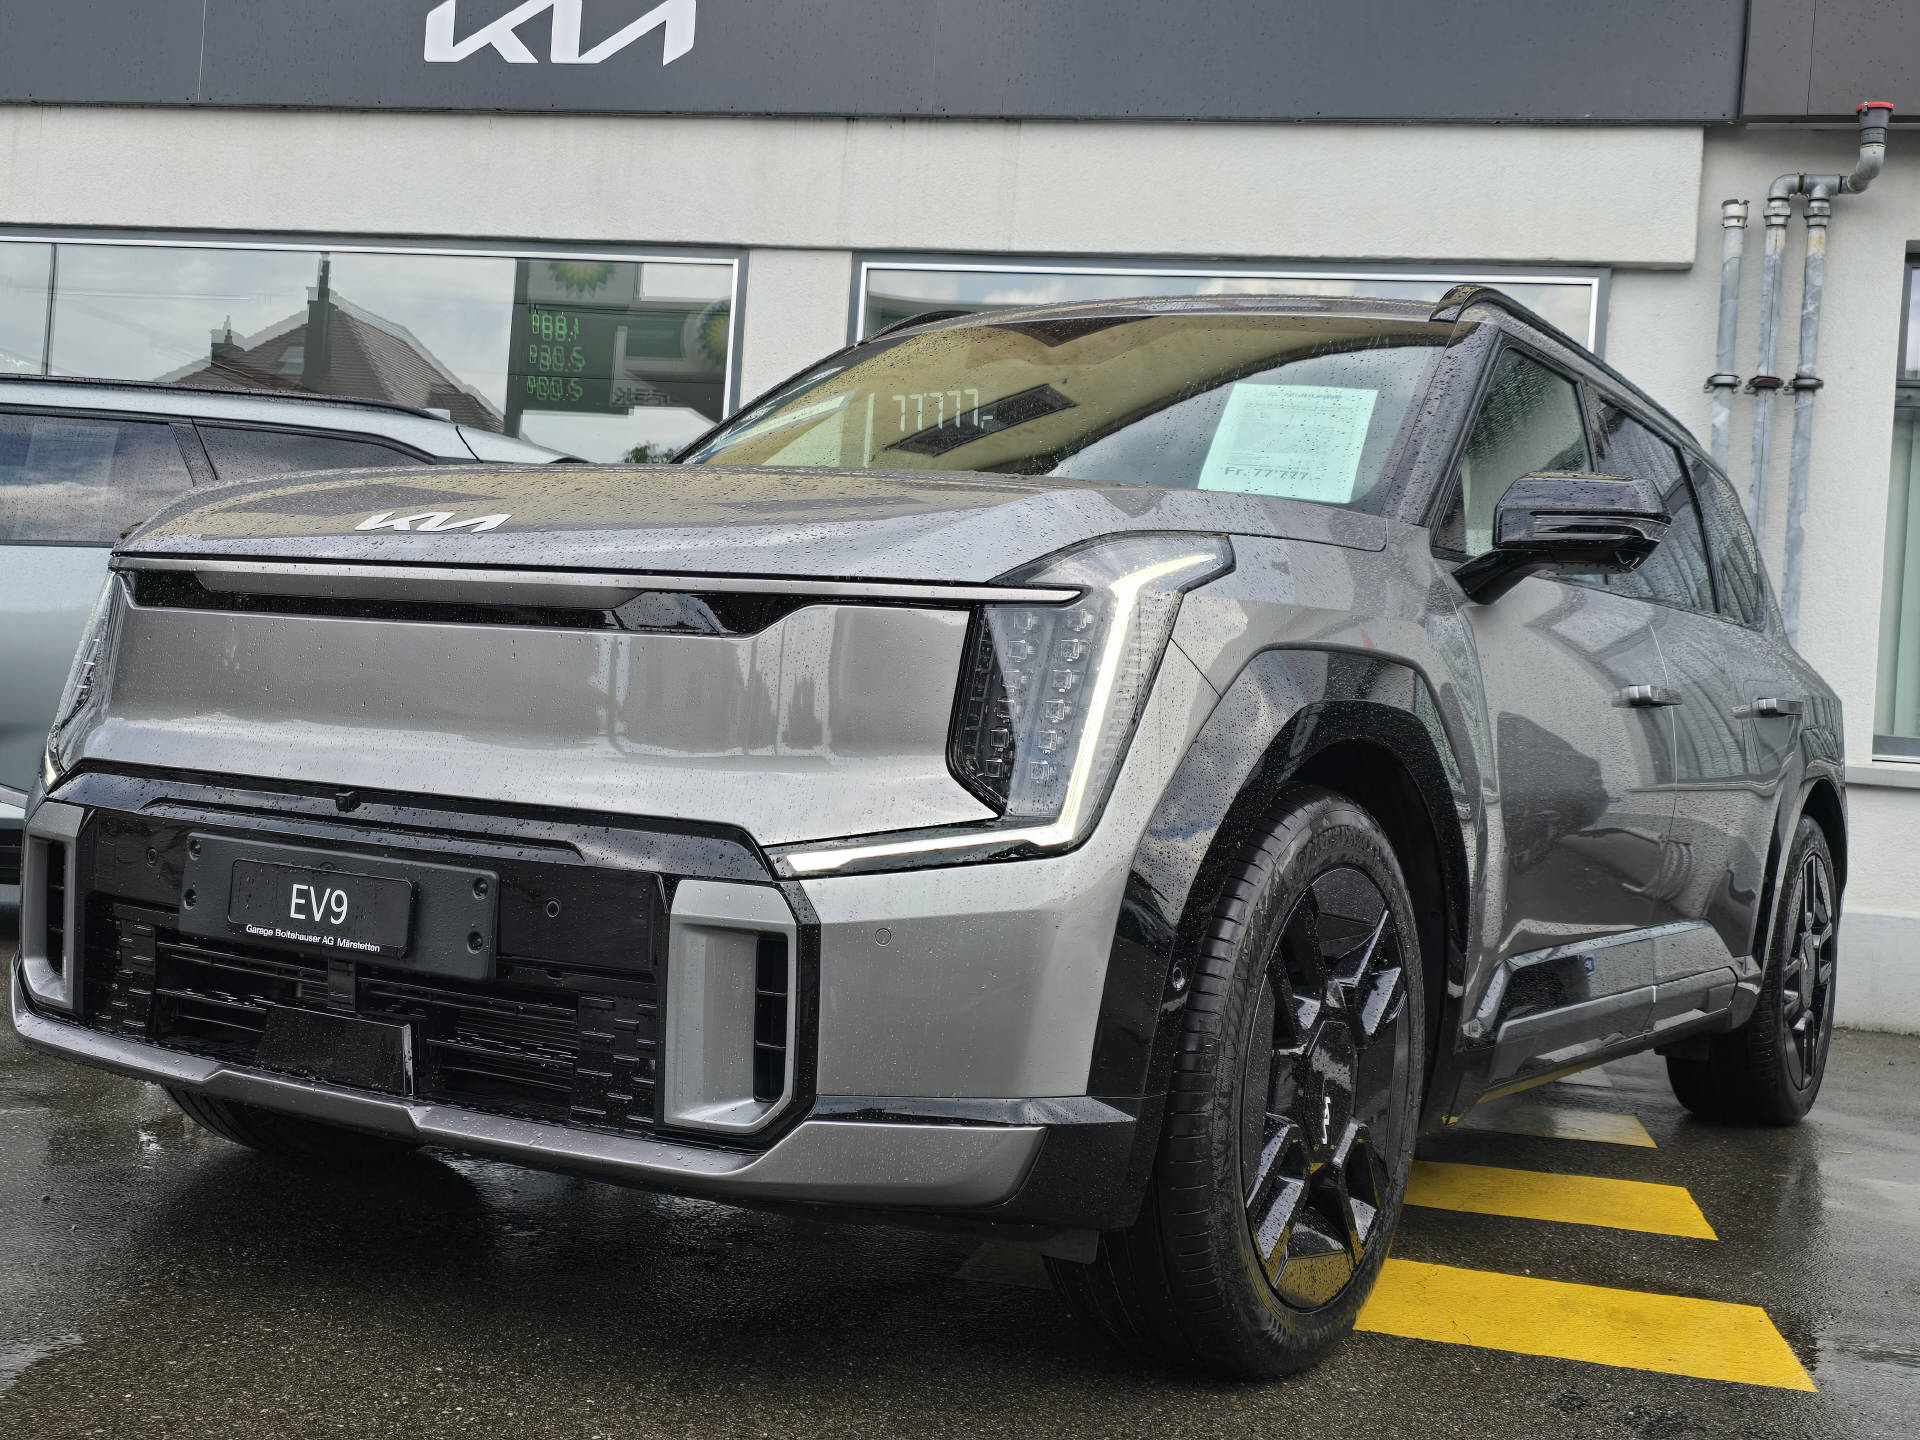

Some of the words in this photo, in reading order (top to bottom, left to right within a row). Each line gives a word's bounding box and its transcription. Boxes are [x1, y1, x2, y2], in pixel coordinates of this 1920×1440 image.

[424, 0, 697, 66] KIA
[355, 511, 512, 533] KIA
[289, 883, 348, 925] EV9
[246, 924, 273, 936] Garage
[275, 928, 321, 943] Boltshauser
[322, 935, 334, 946] AG
